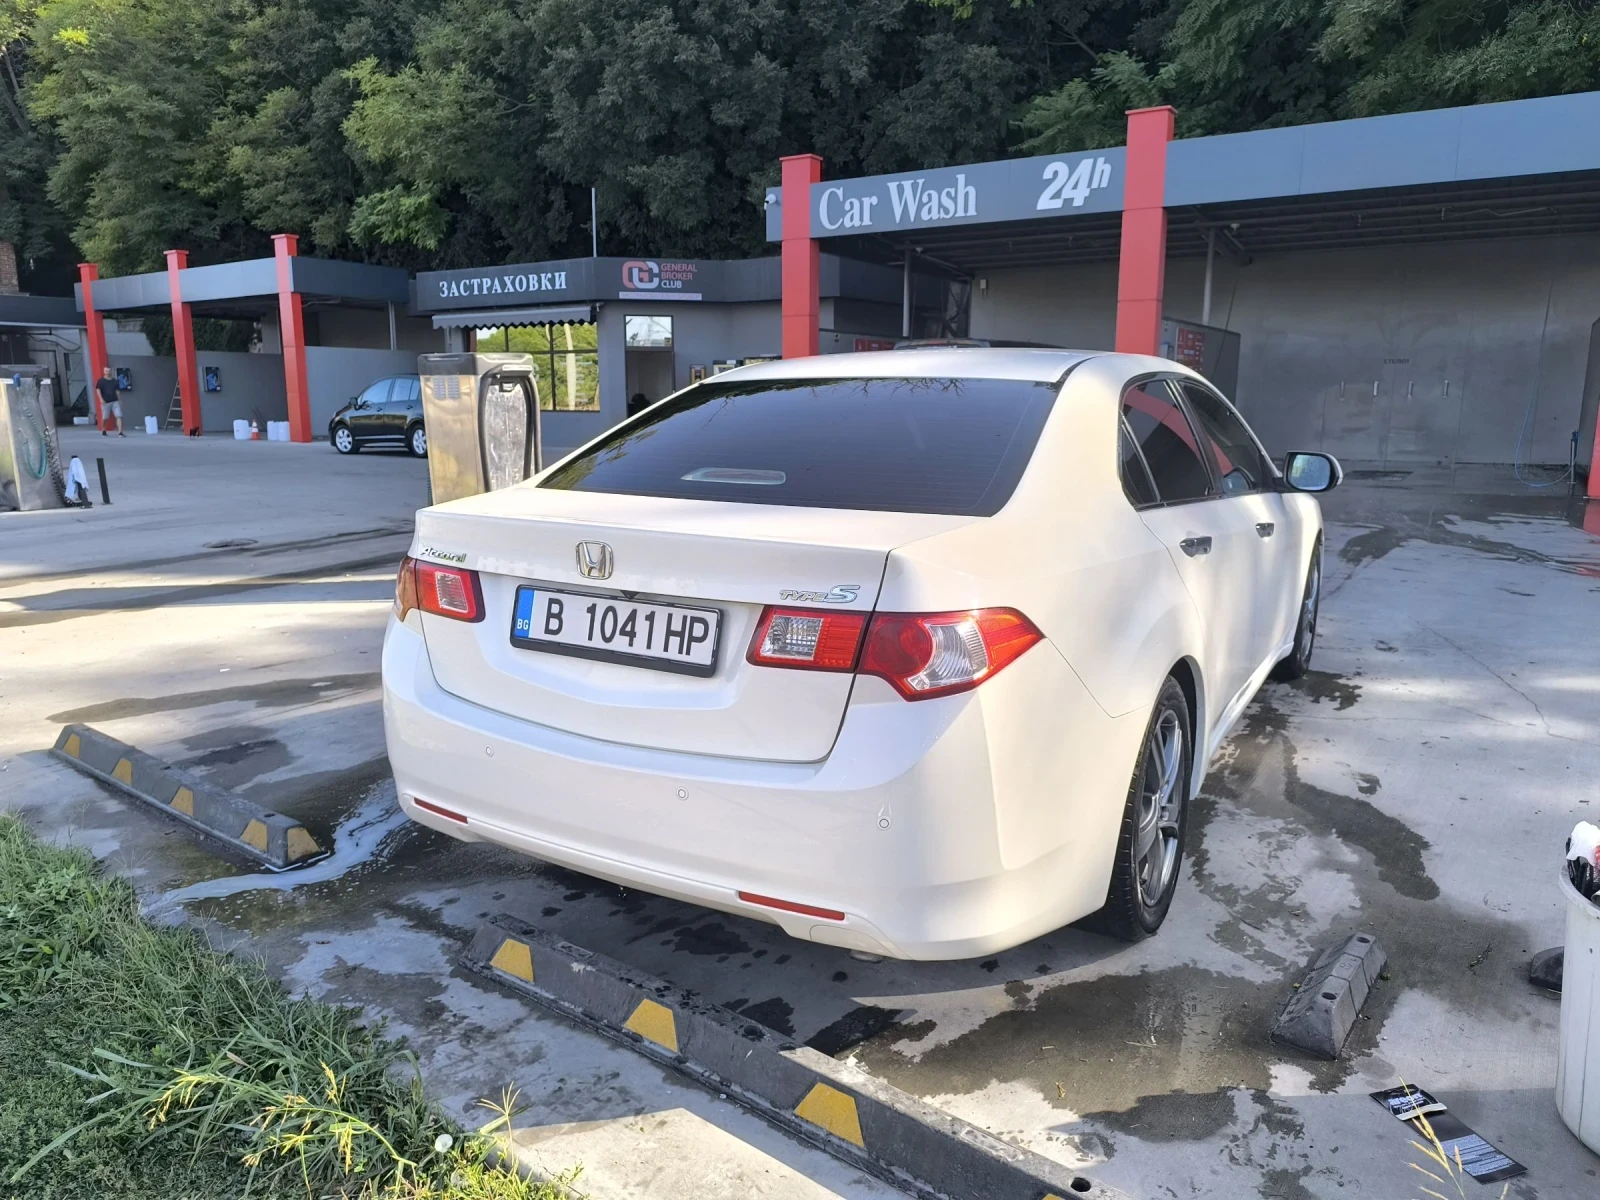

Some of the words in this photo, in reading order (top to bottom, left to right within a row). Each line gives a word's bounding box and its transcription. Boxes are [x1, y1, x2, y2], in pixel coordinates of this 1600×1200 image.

[1036, 157, 1112, 210] 24h
[819, 187, 878, 230] Car
[887, 174, 977, 224] Wash
[661, 263, 698, 272] GENERAL
[661, 271, 693, 280] BROKER
[439, 271, 567, 298] ЗАСТРАХОВКИ
[661, 280, 682, 289] CLUB
[420, 547, 467, 563] Accord
[779, 589, 828, 602] TYPE
[544, 597, 564, 636] B
[516, 618, 529, 631] BG
